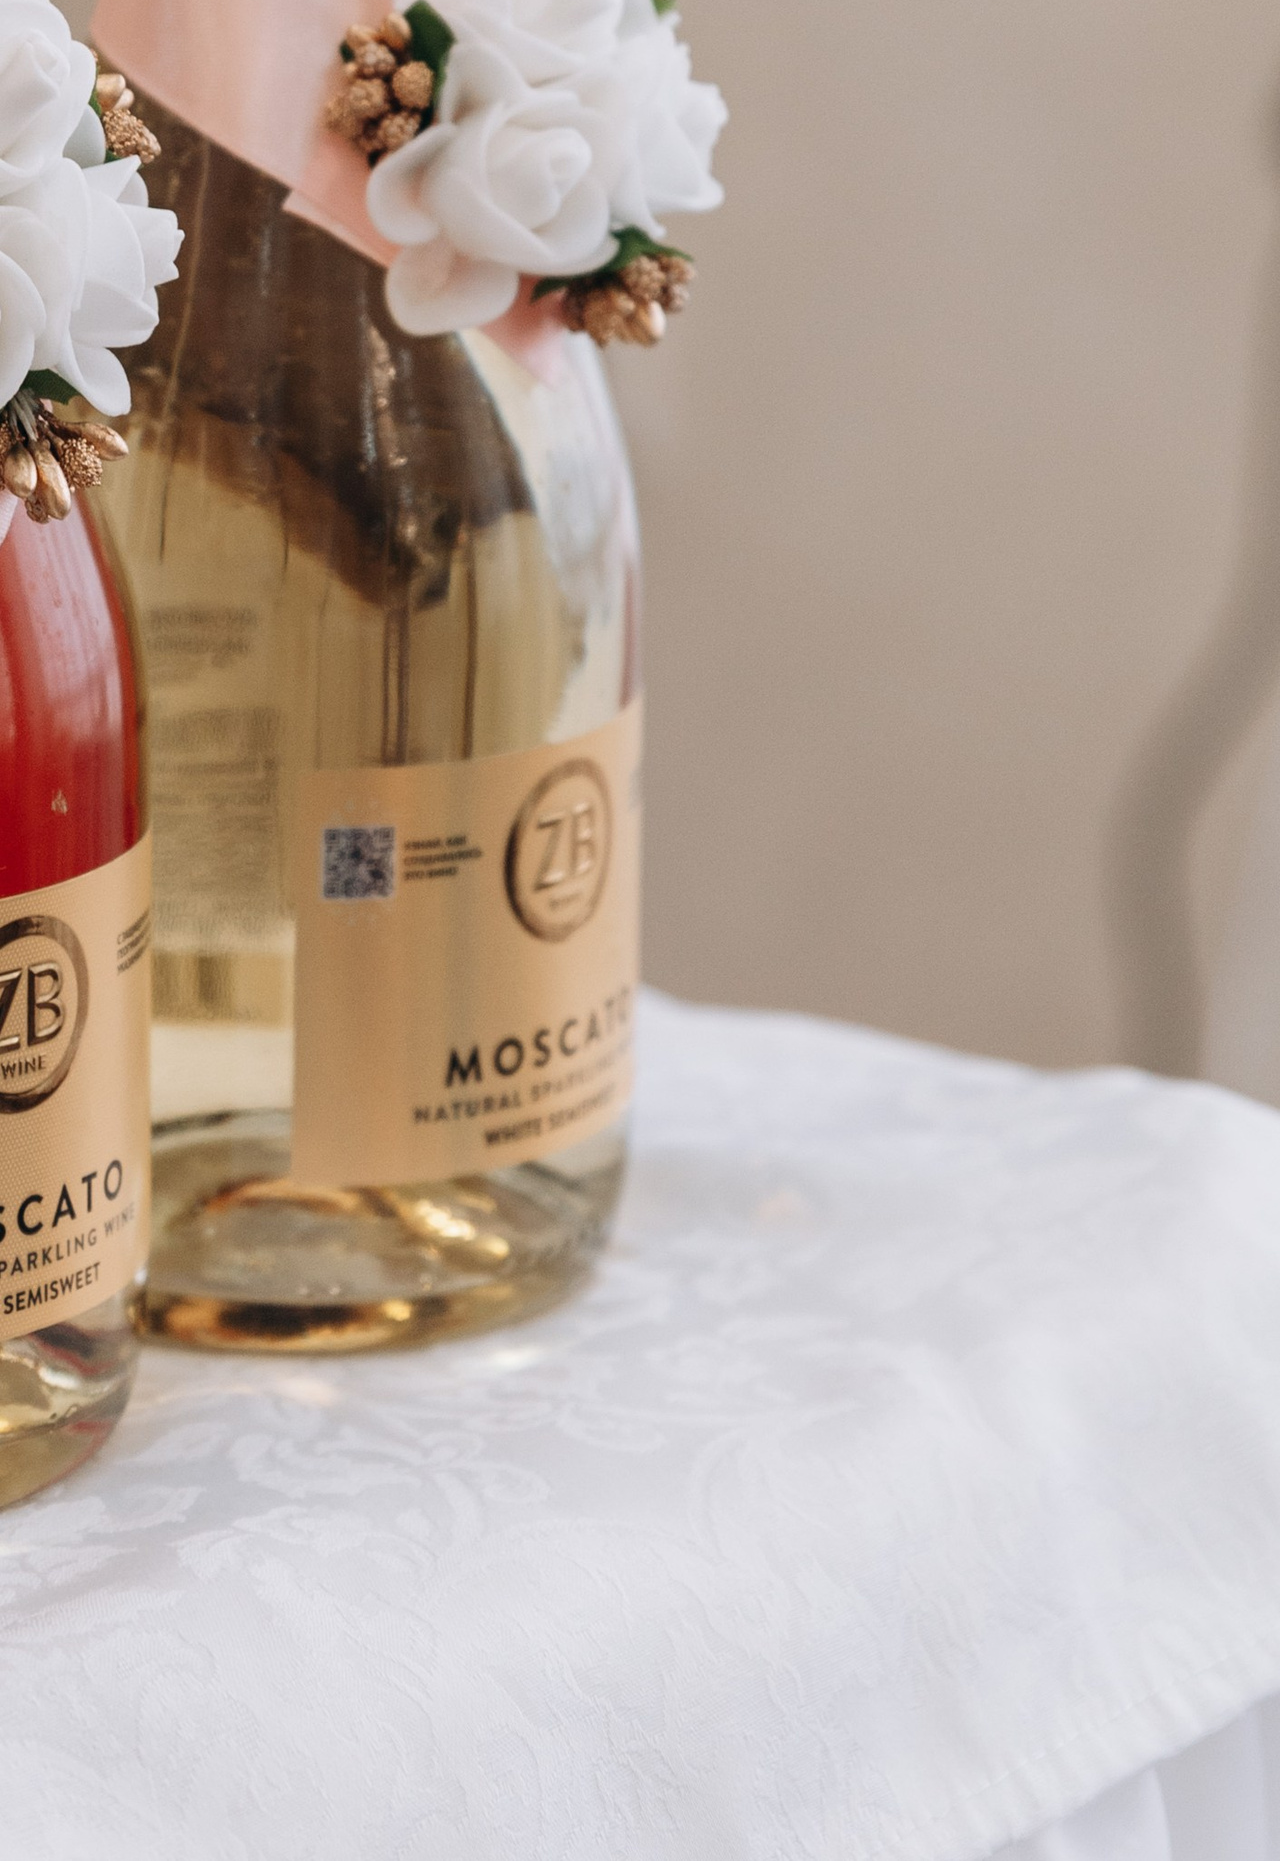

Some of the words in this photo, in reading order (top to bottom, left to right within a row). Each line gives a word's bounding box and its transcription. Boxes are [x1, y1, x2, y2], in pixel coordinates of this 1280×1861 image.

[534, 802, 596, 891] ZB
[1, 1055, 48, 1080] WINE
[104, 1201, 136, 1238] WINE
[3, 1261, 101, 1315] SEMISWEET
